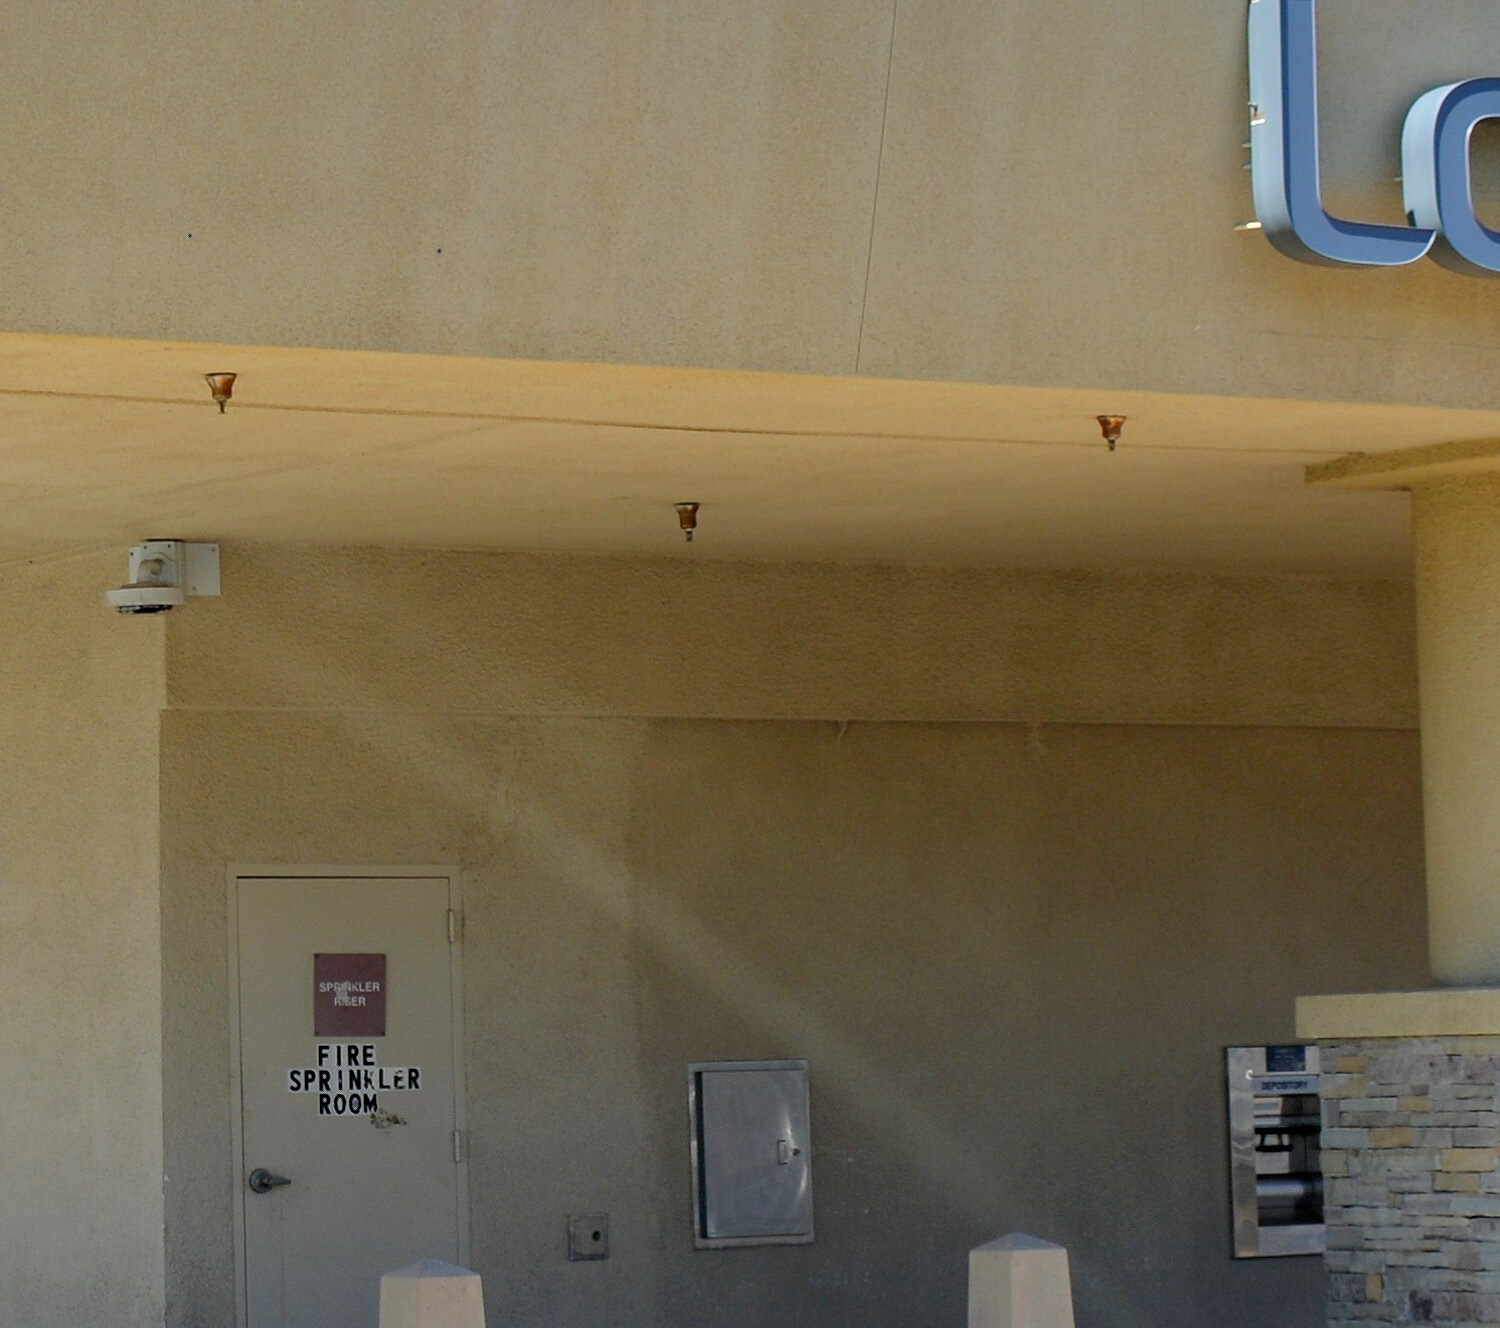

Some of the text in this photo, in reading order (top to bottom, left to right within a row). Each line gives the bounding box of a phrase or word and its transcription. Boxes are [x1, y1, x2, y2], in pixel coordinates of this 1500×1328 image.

[319, 981, 381, 993] SPRINKLER
[334, 996, 366, 1007] RISER
[317, 1044, 376, 1067] FIRE
[289, 1068, 421, 1092] SPRINKLER
[1260, 1081, 1308, 1091] DEPOSITORY
[318, 1093, 378, 1115] ROOM
